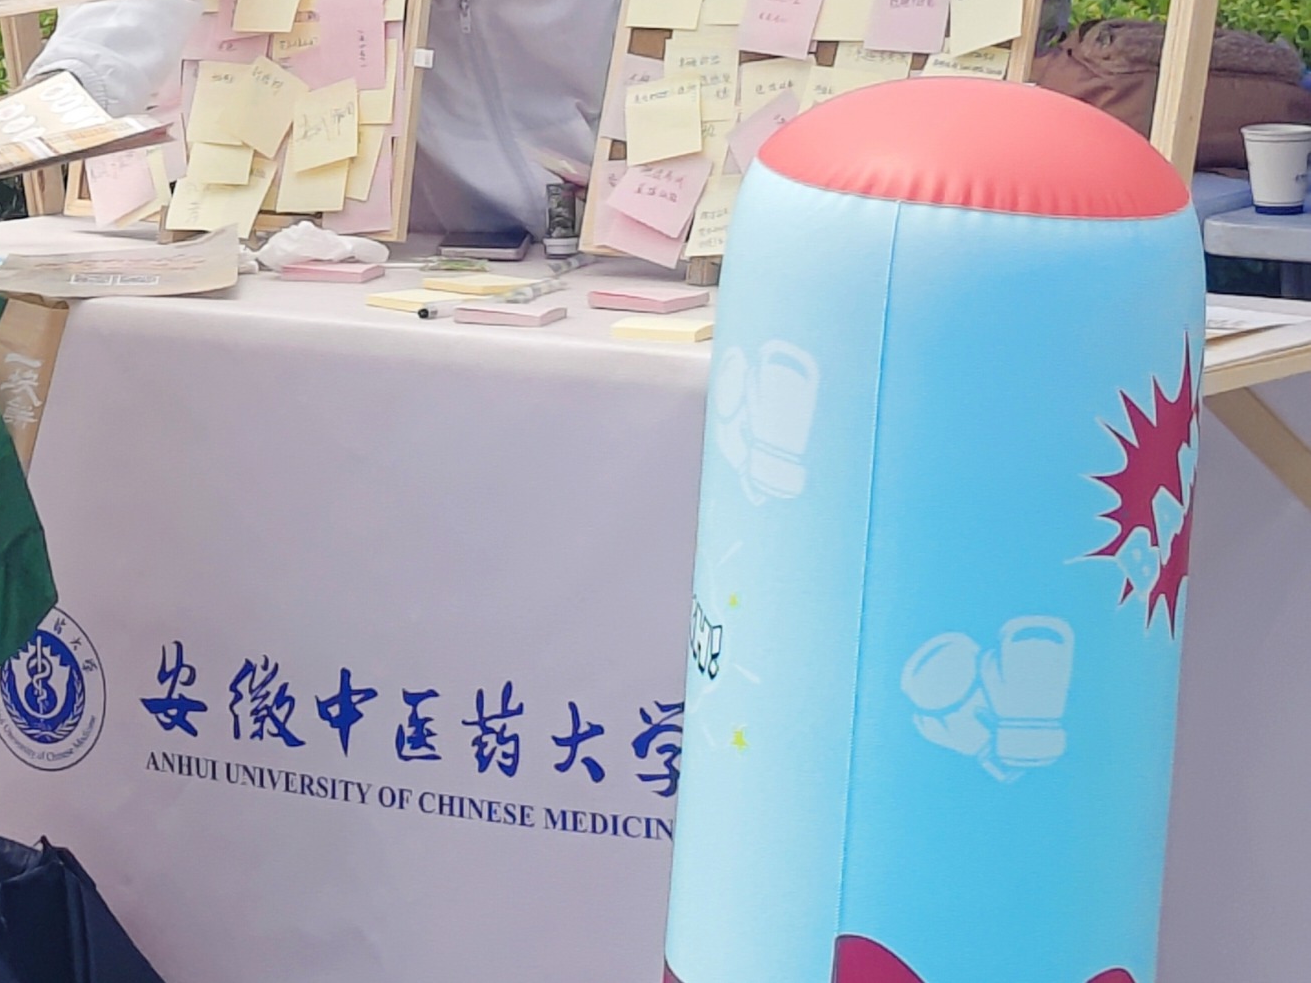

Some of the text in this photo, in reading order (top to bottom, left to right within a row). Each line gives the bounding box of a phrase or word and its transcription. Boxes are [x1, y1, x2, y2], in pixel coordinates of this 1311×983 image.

[140, 639, 685, 797] 安徽中医药大学
[145, 750, 219, 781] ANHUI
[225, 761, 373, 805] UNIVERSITY
[378, 785, 413, 810] OF
[418, 790, 535, 828] CHINESE
